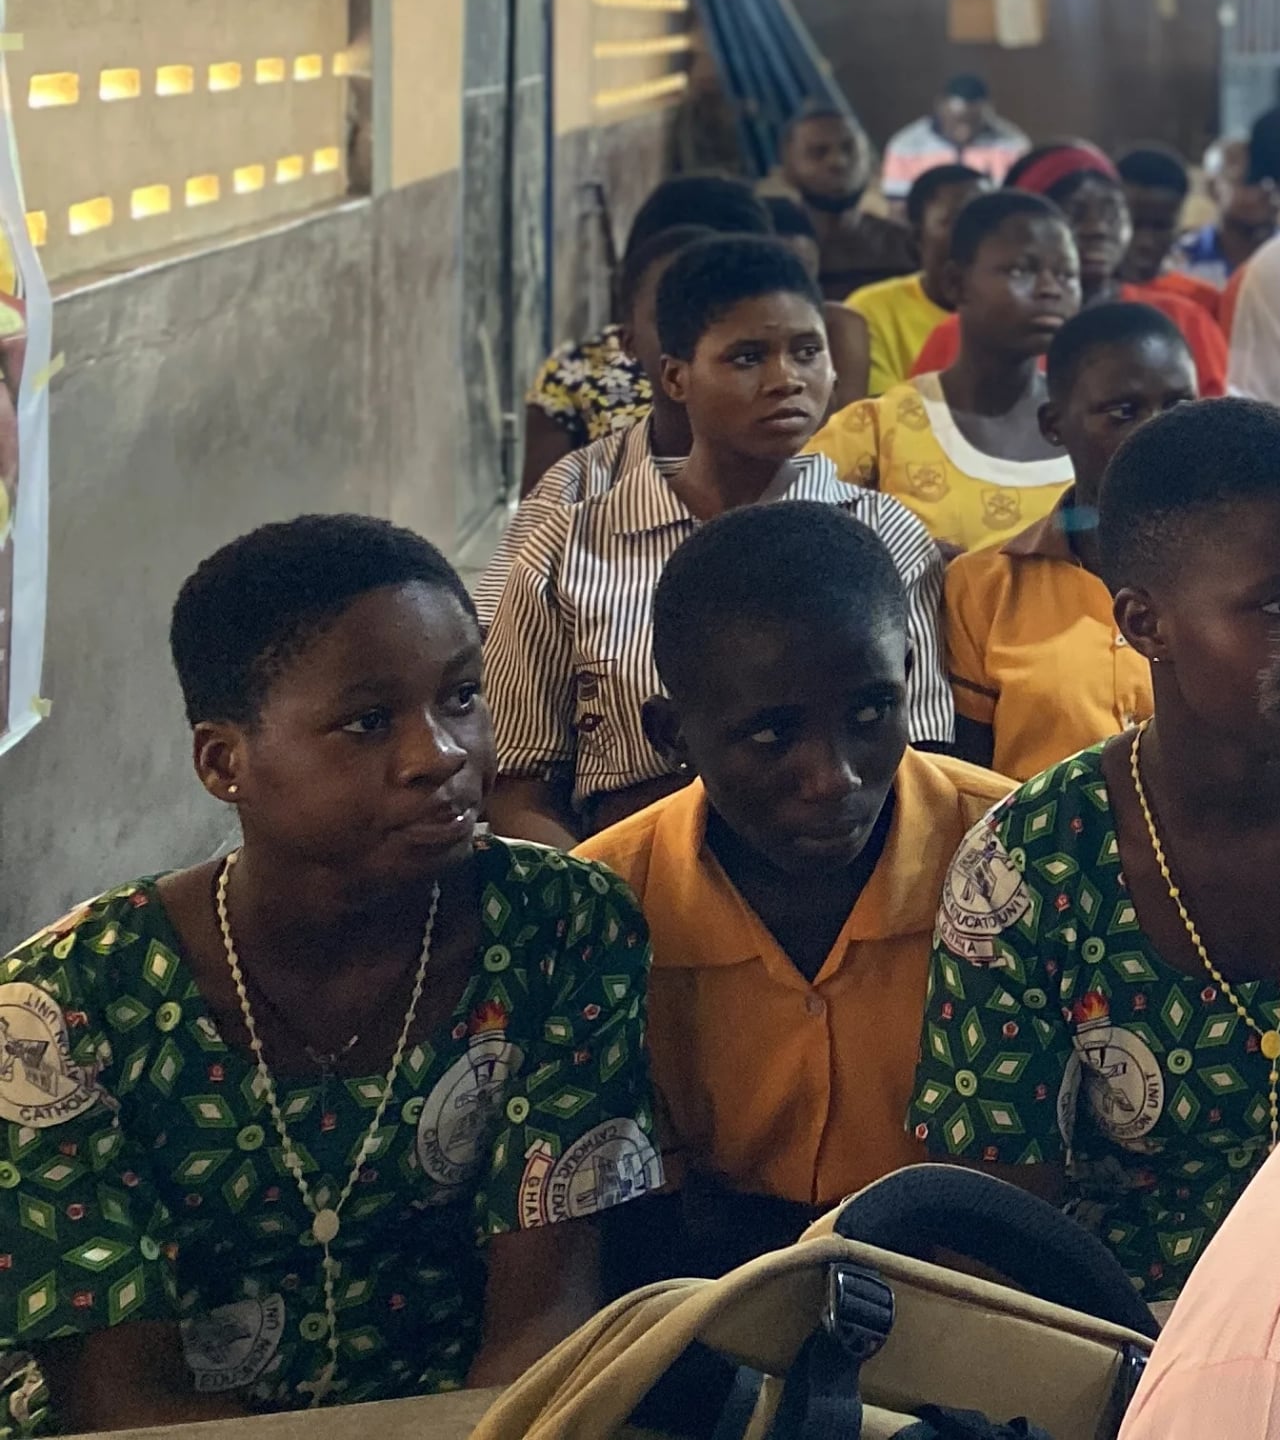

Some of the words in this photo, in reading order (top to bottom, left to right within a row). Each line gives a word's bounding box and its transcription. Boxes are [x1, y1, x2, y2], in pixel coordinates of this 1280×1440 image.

[24, 992, 57, 1025] UNIT
[19, 1088, 90, 1121] CATHOL
[1146, 1073, 1160, 1109] UNIT
[557, 1125, 618, 1179] CATHOLIC
